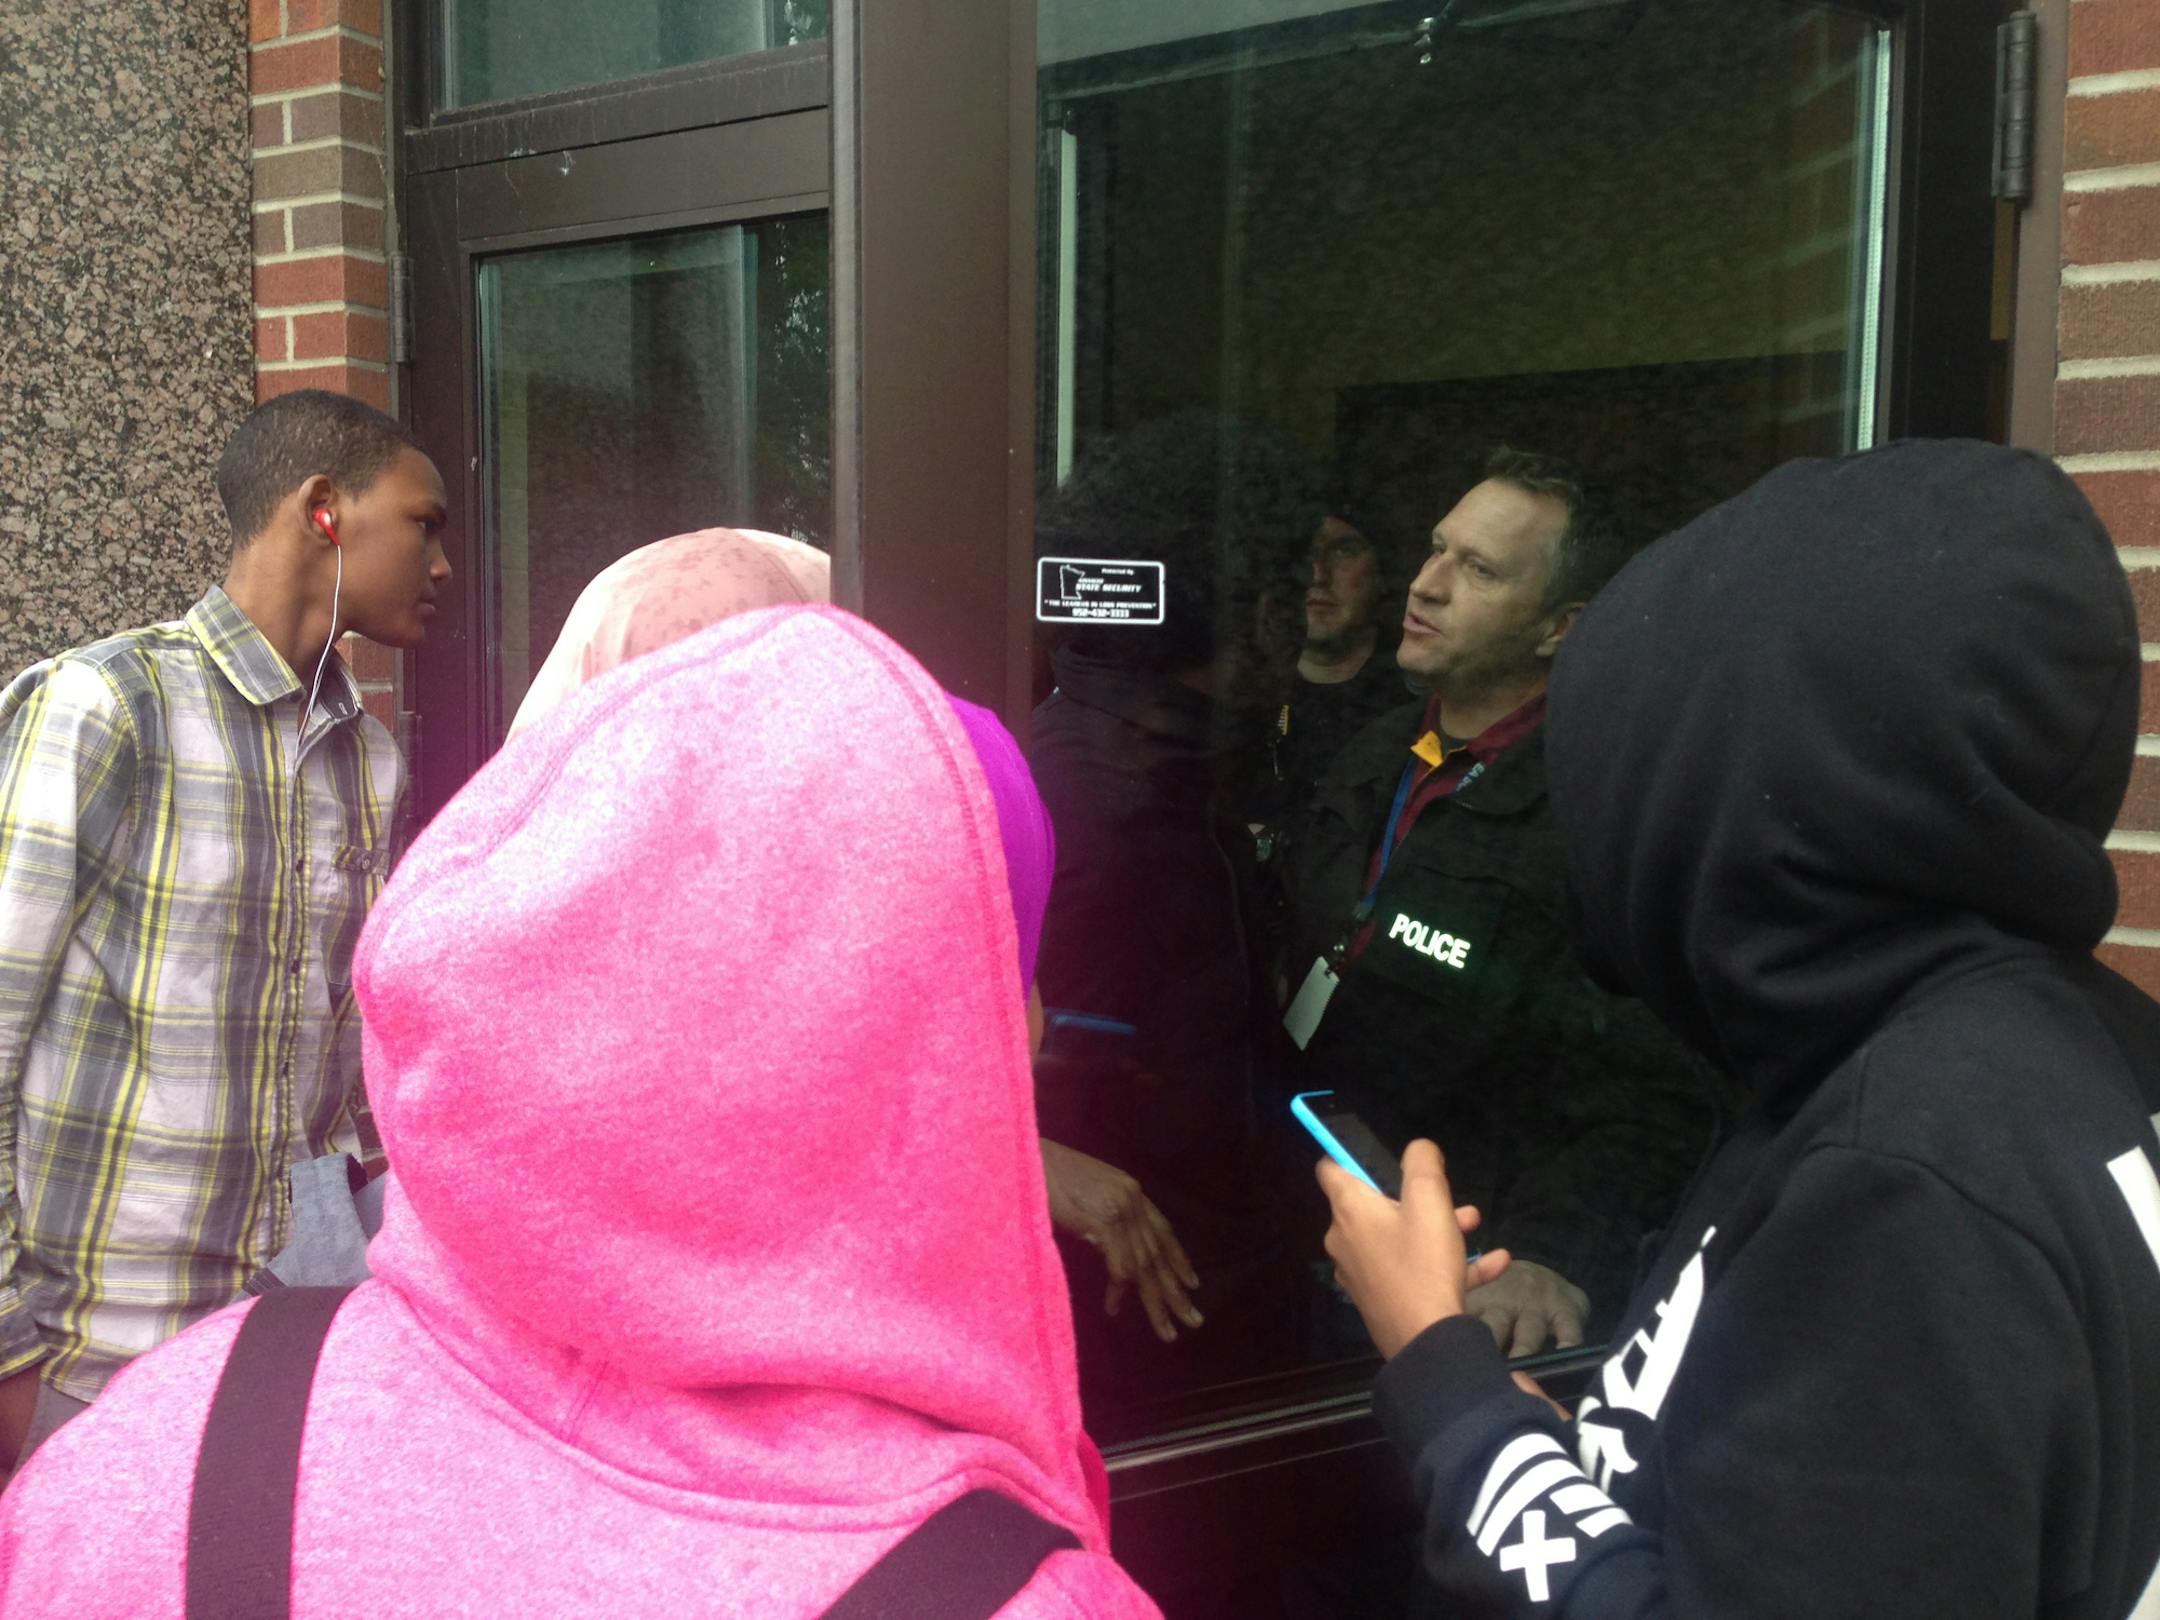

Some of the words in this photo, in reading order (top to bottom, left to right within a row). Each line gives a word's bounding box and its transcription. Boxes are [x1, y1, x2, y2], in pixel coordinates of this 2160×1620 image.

[1076, 583, 1100, 592] STATE
[1102, 584, 1142, 593] SECURITY
[1389, 913, 1471, 969] POLICE
